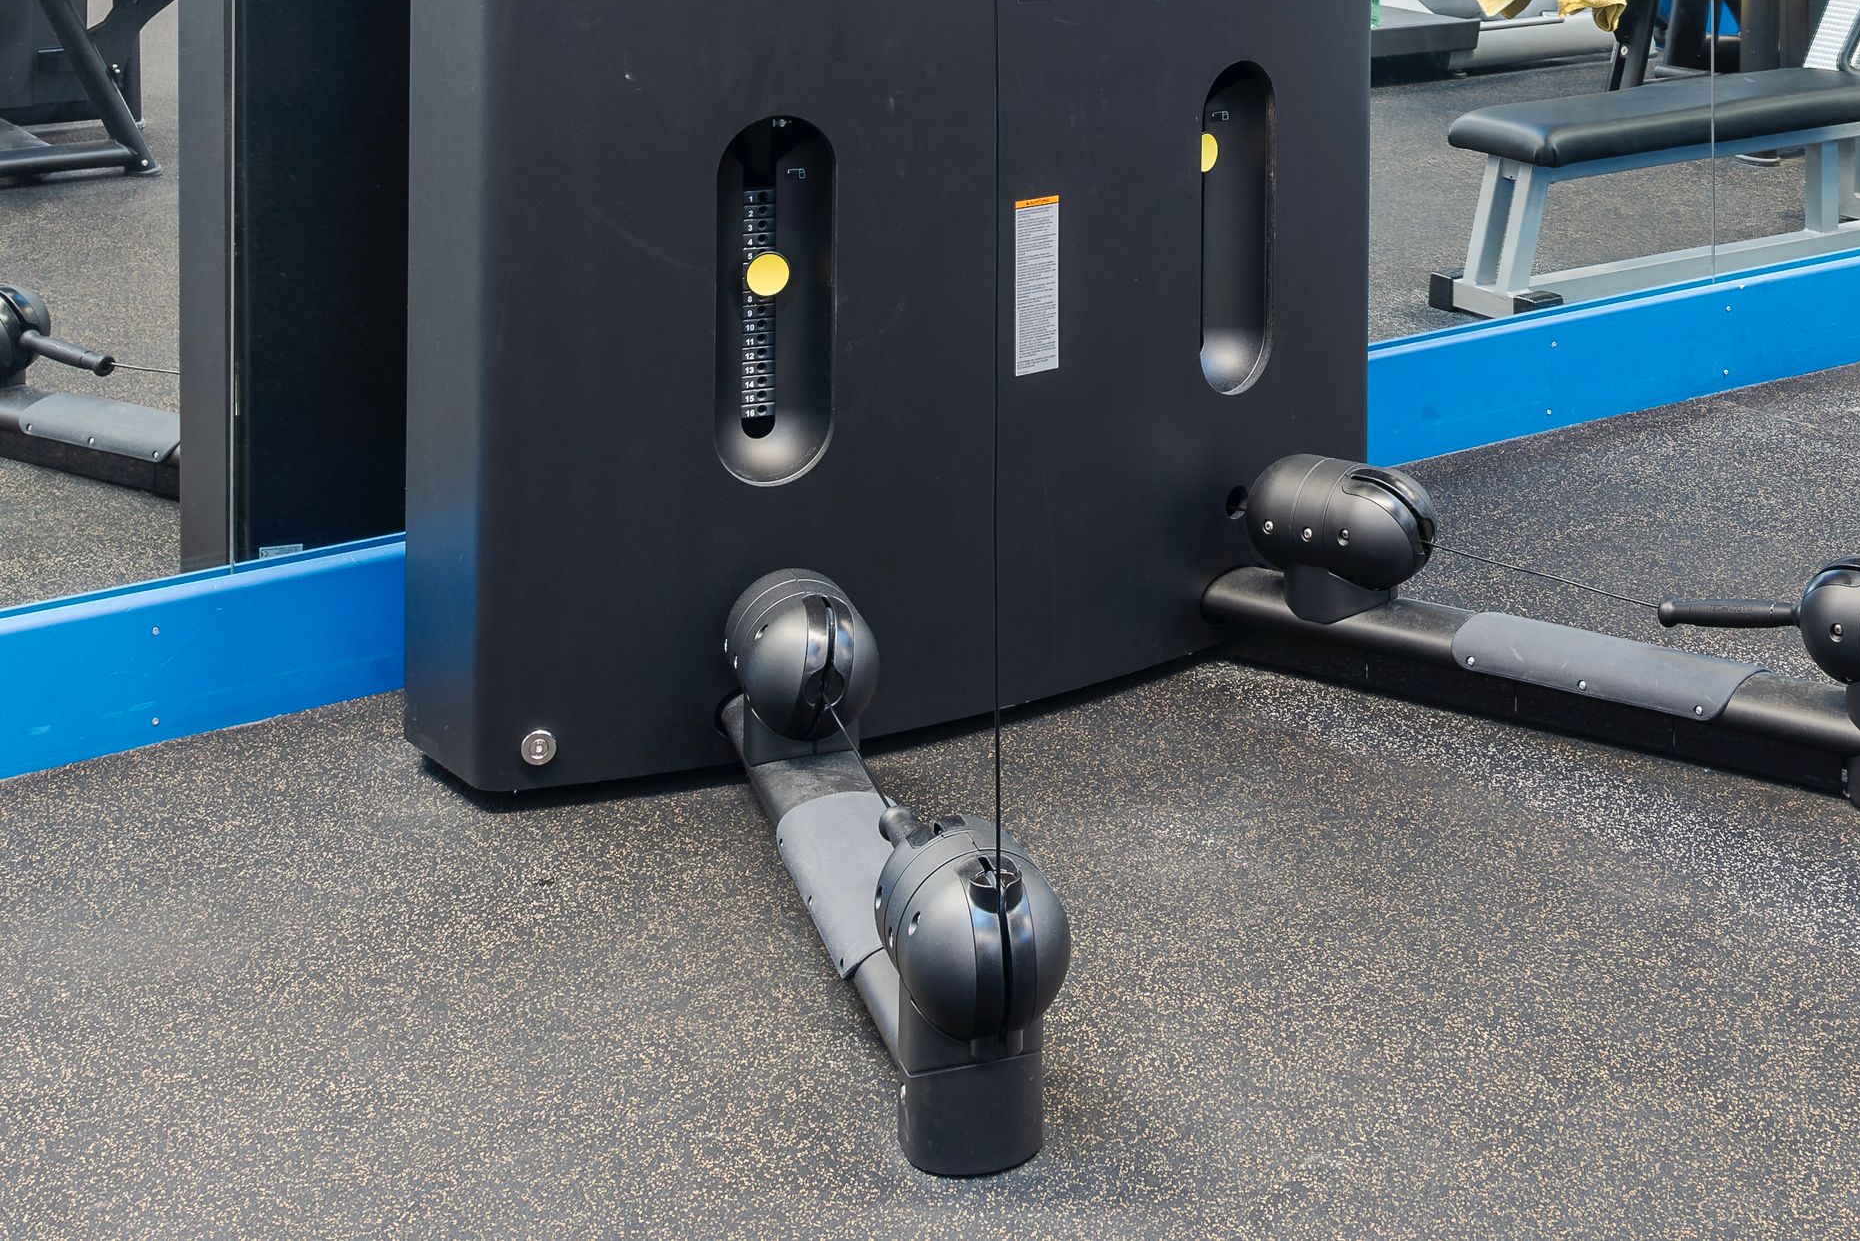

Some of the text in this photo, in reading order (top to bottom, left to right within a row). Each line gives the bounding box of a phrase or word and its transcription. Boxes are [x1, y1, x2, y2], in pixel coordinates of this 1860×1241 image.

[747, 252, 753, 260] 5
[747, 295, 753, 303] 8
[747, 309, 753, 317] 9
[745, 352, 755, 360] 12
[745, 366, 755, 374] 13
[745, 380, 755, 388] 14
[745, 394, 755, 402] 15
[745, 409, 755, 417] 16
